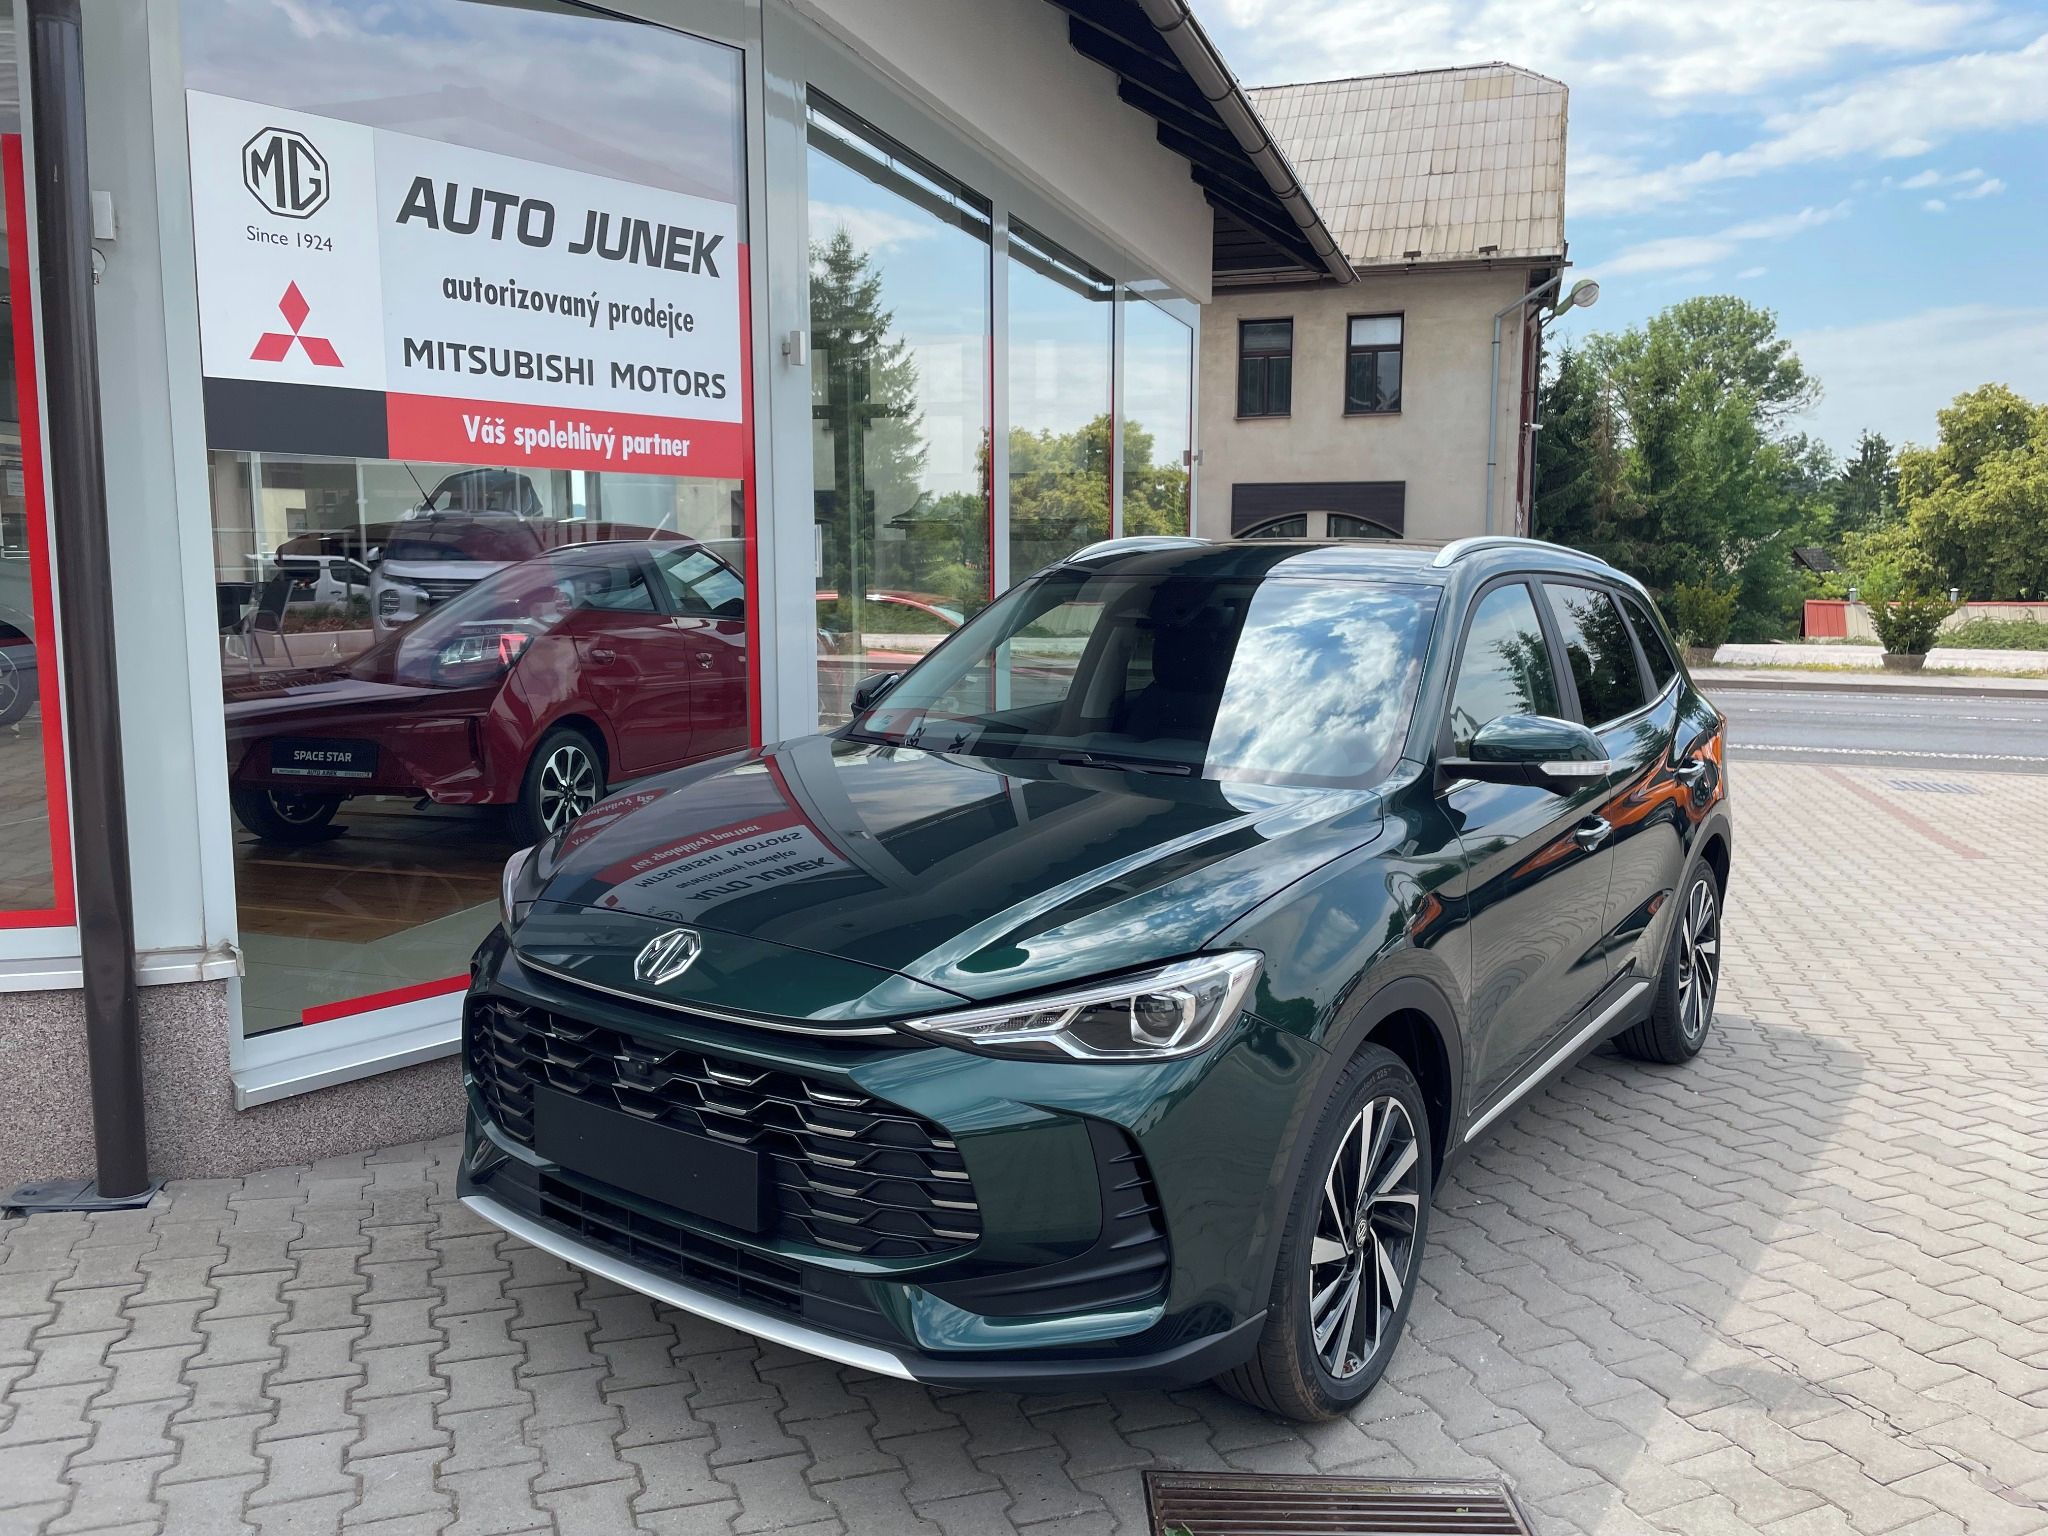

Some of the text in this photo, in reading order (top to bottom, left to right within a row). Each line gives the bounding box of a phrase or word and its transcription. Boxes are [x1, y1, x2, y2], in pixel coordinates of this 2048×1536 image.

[249, 134, 323, 212] MG
[246, 225, 333, 252] Since 1924
[395, 176, 725, 279] AUTO JUNEK
[442, 276, 694, 339] autorizovaný prodejce
[403, 337, 726, 399] MITSUBISHI MOTORS
[462, 414, 690, 461] Váš spolehlivý partner
[293, 750, 352, 763] SPACE STAR
